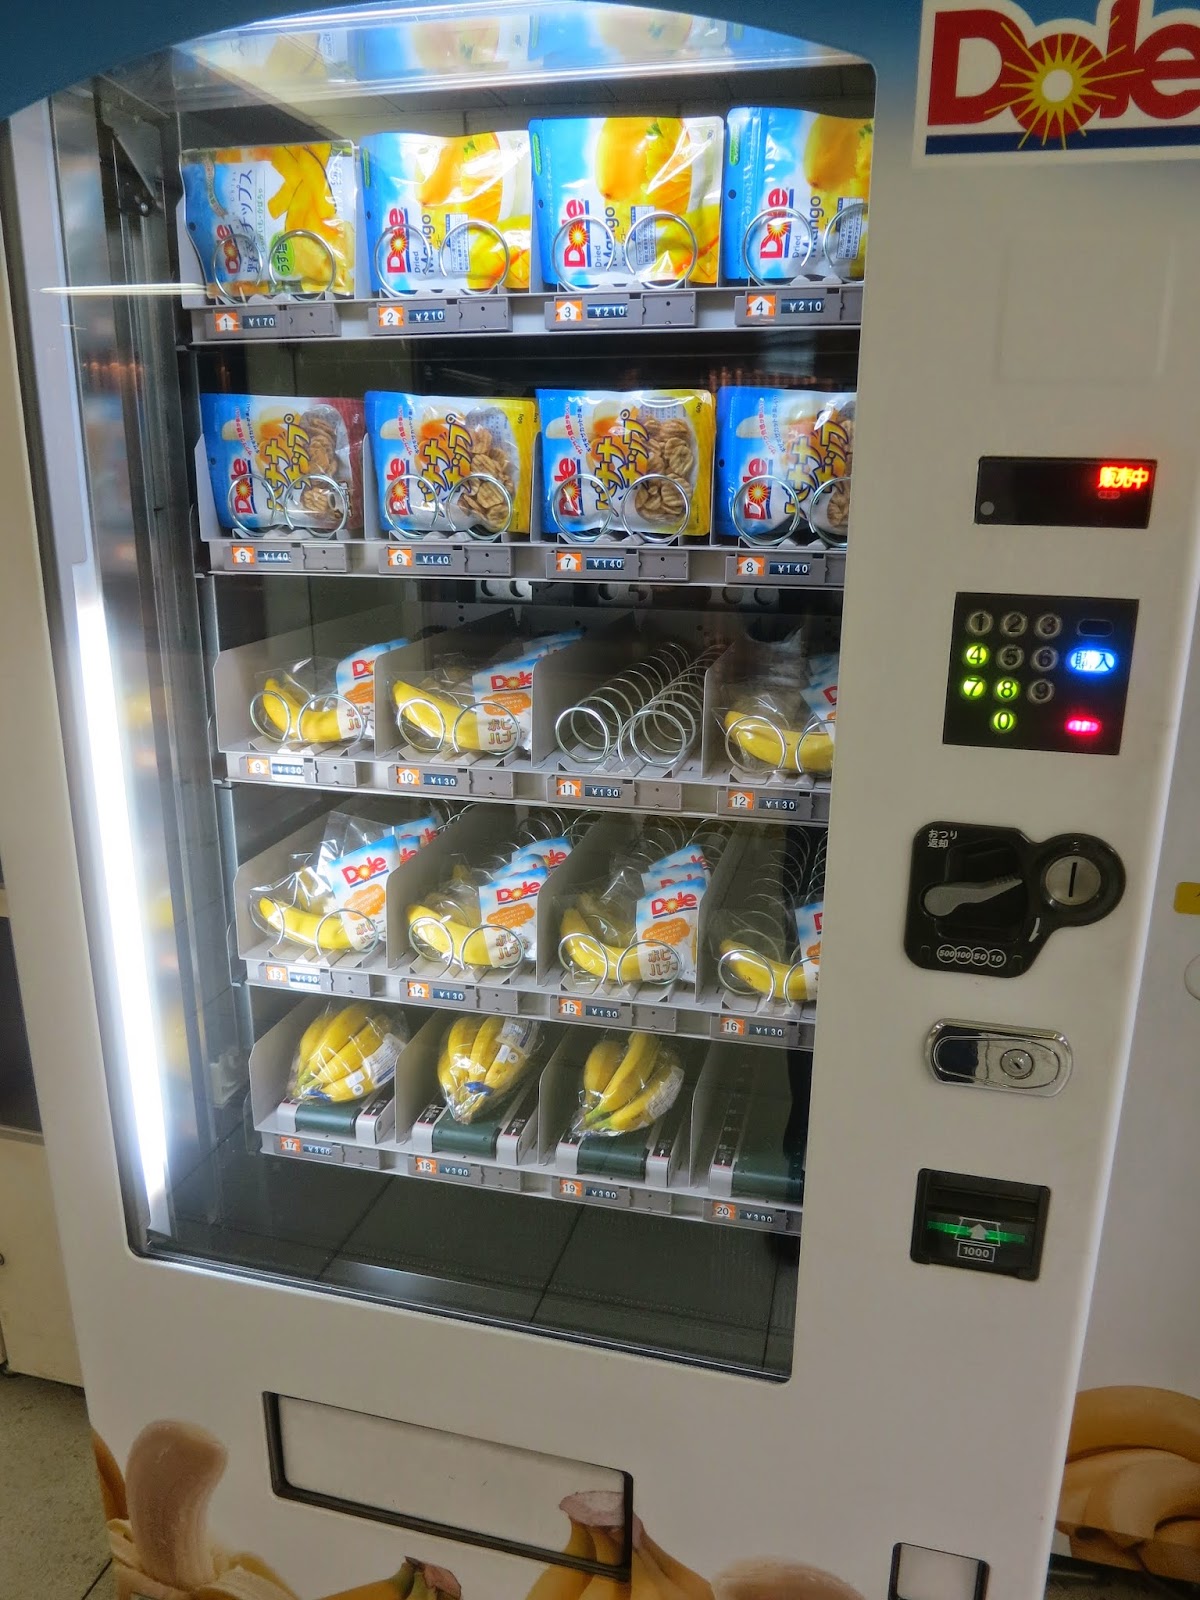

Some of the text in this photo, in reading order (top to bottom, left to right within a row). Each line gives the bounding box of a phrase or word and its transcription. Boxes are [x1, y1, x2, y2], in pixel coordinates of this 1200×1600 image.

[928, 0, 1200, 139] Dole
[563, 199, 587, 268] Dole
[791, 235, 801, 259] Dried
[594, 245, 602, 268] Dried
[564, 306, 572, 318] 3
[594, 305, 625, 317] ¥210
[756, 301, 764, 313] 4
[789, 301, 822, 313] ¥210
[387, 313, 394, 325] 2
[415, 311, 444, 323] ¥210
[240, 550, 247, 562] 5
[396, 553, 403, 565] 6
[565, 557, 571, 569] 7
[593, 558, 623, 569] ¥140
[746, 561, 754, 573] 8
[778, 564, 809, 574] ¥140
[402, 772, 414, 783] 10
[430, 776, 456, 786] ¥130
[562, 785, 573, 795] 11
[592, 788, 619, 798] ¥130
[733, 796, 746, 807] 12
[765, 800, 795, 810] ¥130
[928, 829, 958, 840] おつり
[927, 839, 949, 849] 返却
[341, 857, 387, 884] Dole
[496, 881, 540, 902] Dole
[651, 892, 697, 915] Dole
[940, 949, 1003, 963] 500 100 50 10
[412, 985, 424, 996] 14
[439, 991, 464, 1000] ¥130
[564, 1003, 575, 1014] 15
[591, 1008, 618, 1019] ¥130
[725, 1021, 738, 1032] 16
[755, 1027, 783, 1037] ¥130
[285, 1140, 295, 1150] 17
[420, 1162, 431, 1171] 18
[564, 1184, 575, 1193] 19
[591, 1190, 617, 1199] ¥390
[717, 1207, 729, 1216] 20
[746, 1213, 773, 1222] ¥390
[964, 1246, 990, 1258] 1000
